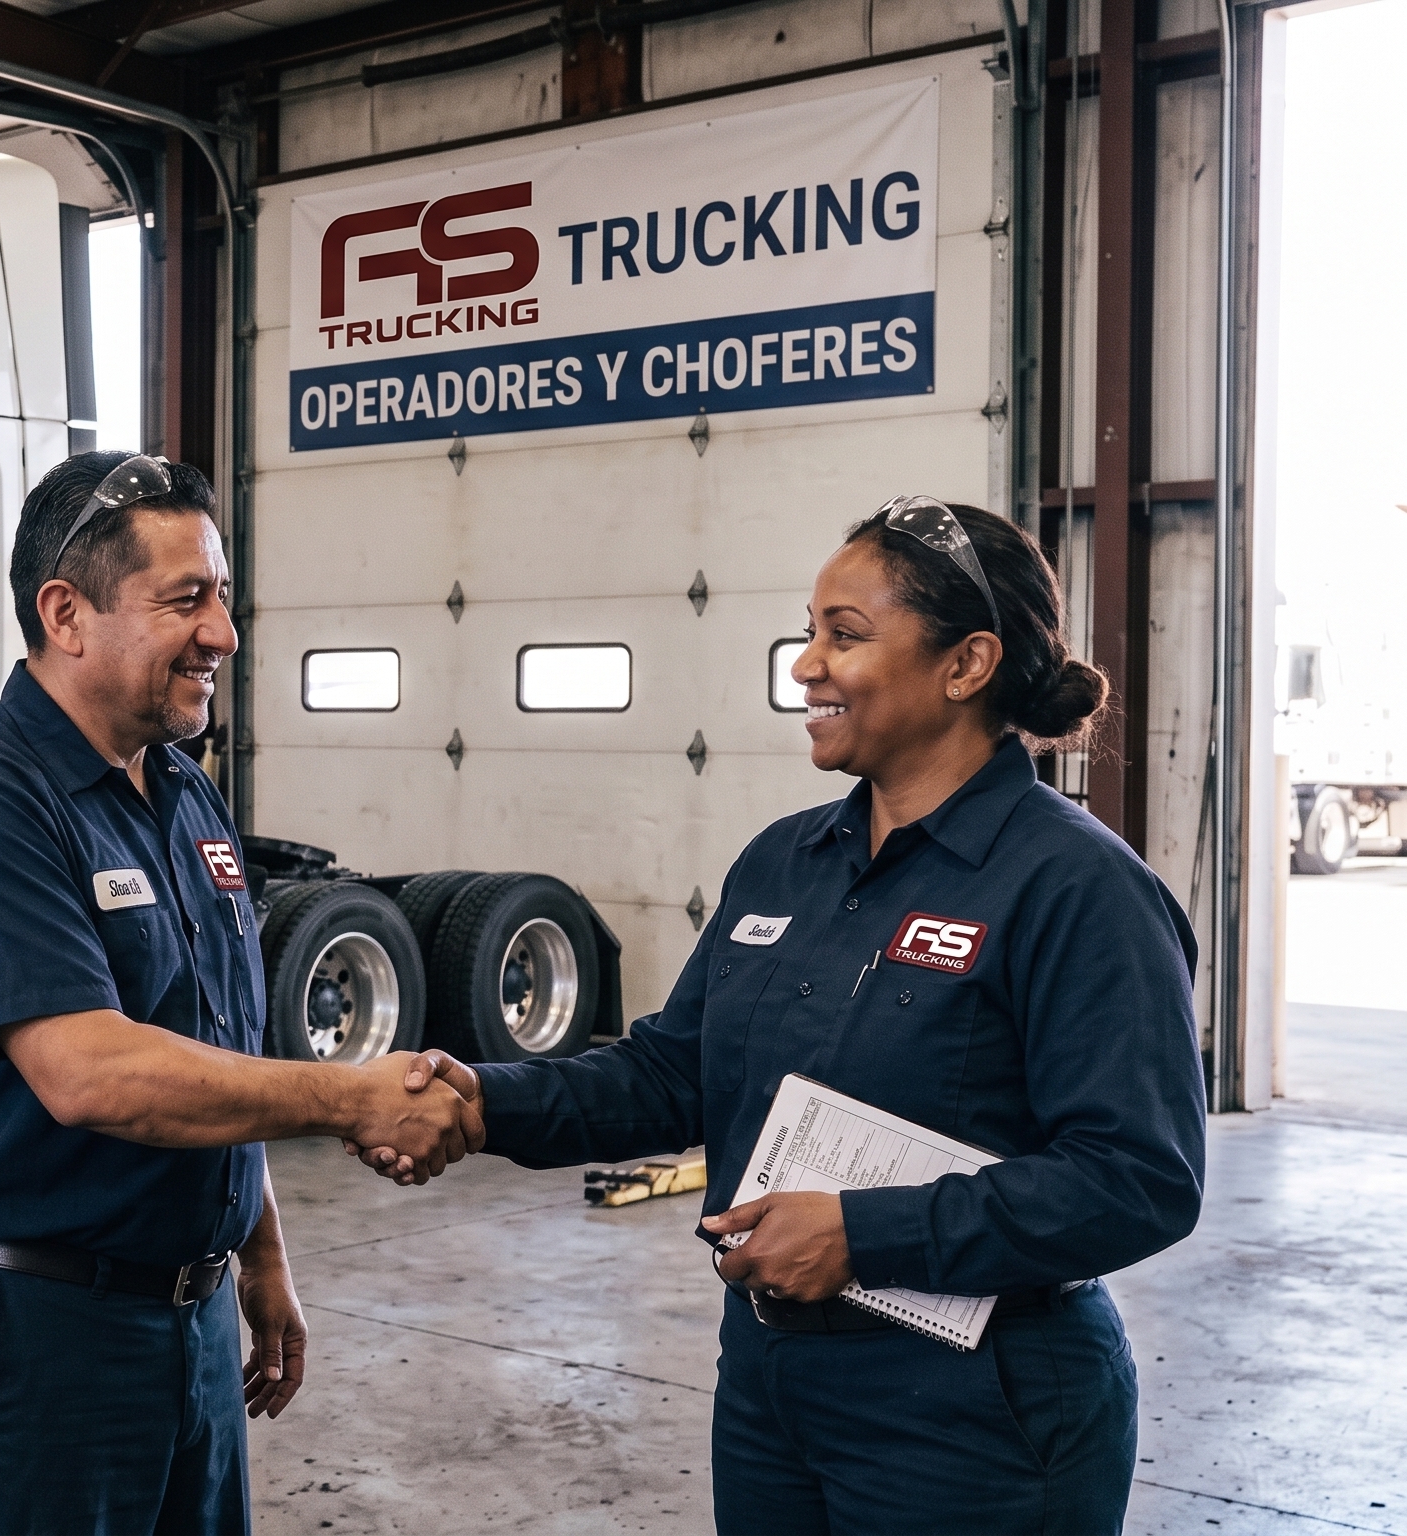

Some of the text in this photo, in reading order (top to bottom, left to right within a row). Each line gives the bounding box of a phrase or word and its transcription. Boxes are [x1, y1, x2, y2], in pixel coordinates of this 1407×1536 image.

[558, 170, 921, 286] TRUCKING
[319, 298, 539, 350] TRUCKING
[300, 317, 917, 430] OPERADORES Y CHOFERES
[895, 948, 965, 969] TRUCKING
